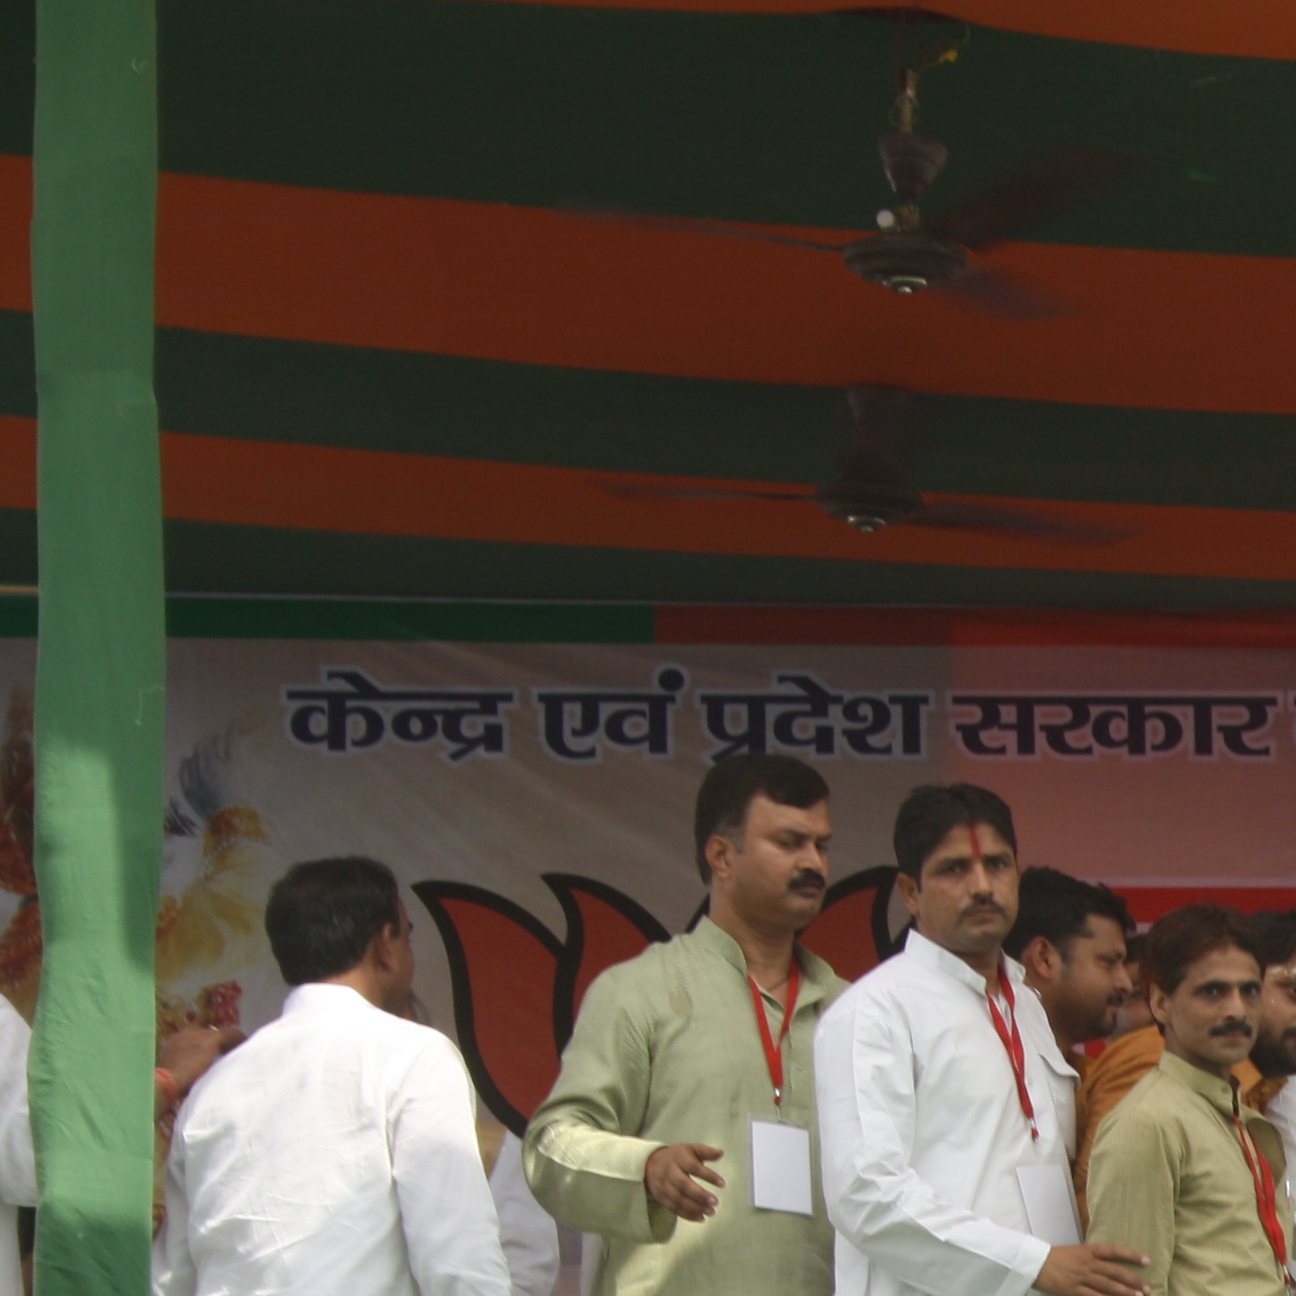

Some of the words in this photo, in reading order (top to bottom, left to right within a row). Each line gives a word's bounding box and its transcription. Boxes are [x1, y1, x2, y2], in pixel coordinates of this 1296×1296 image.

[286, 670, 516, 761] केन्द्र
[536, 667, 687, 759] एवं
[697, 674, 932, 759] प्रदेश
[950, 694, 1279, 758] सरकार
